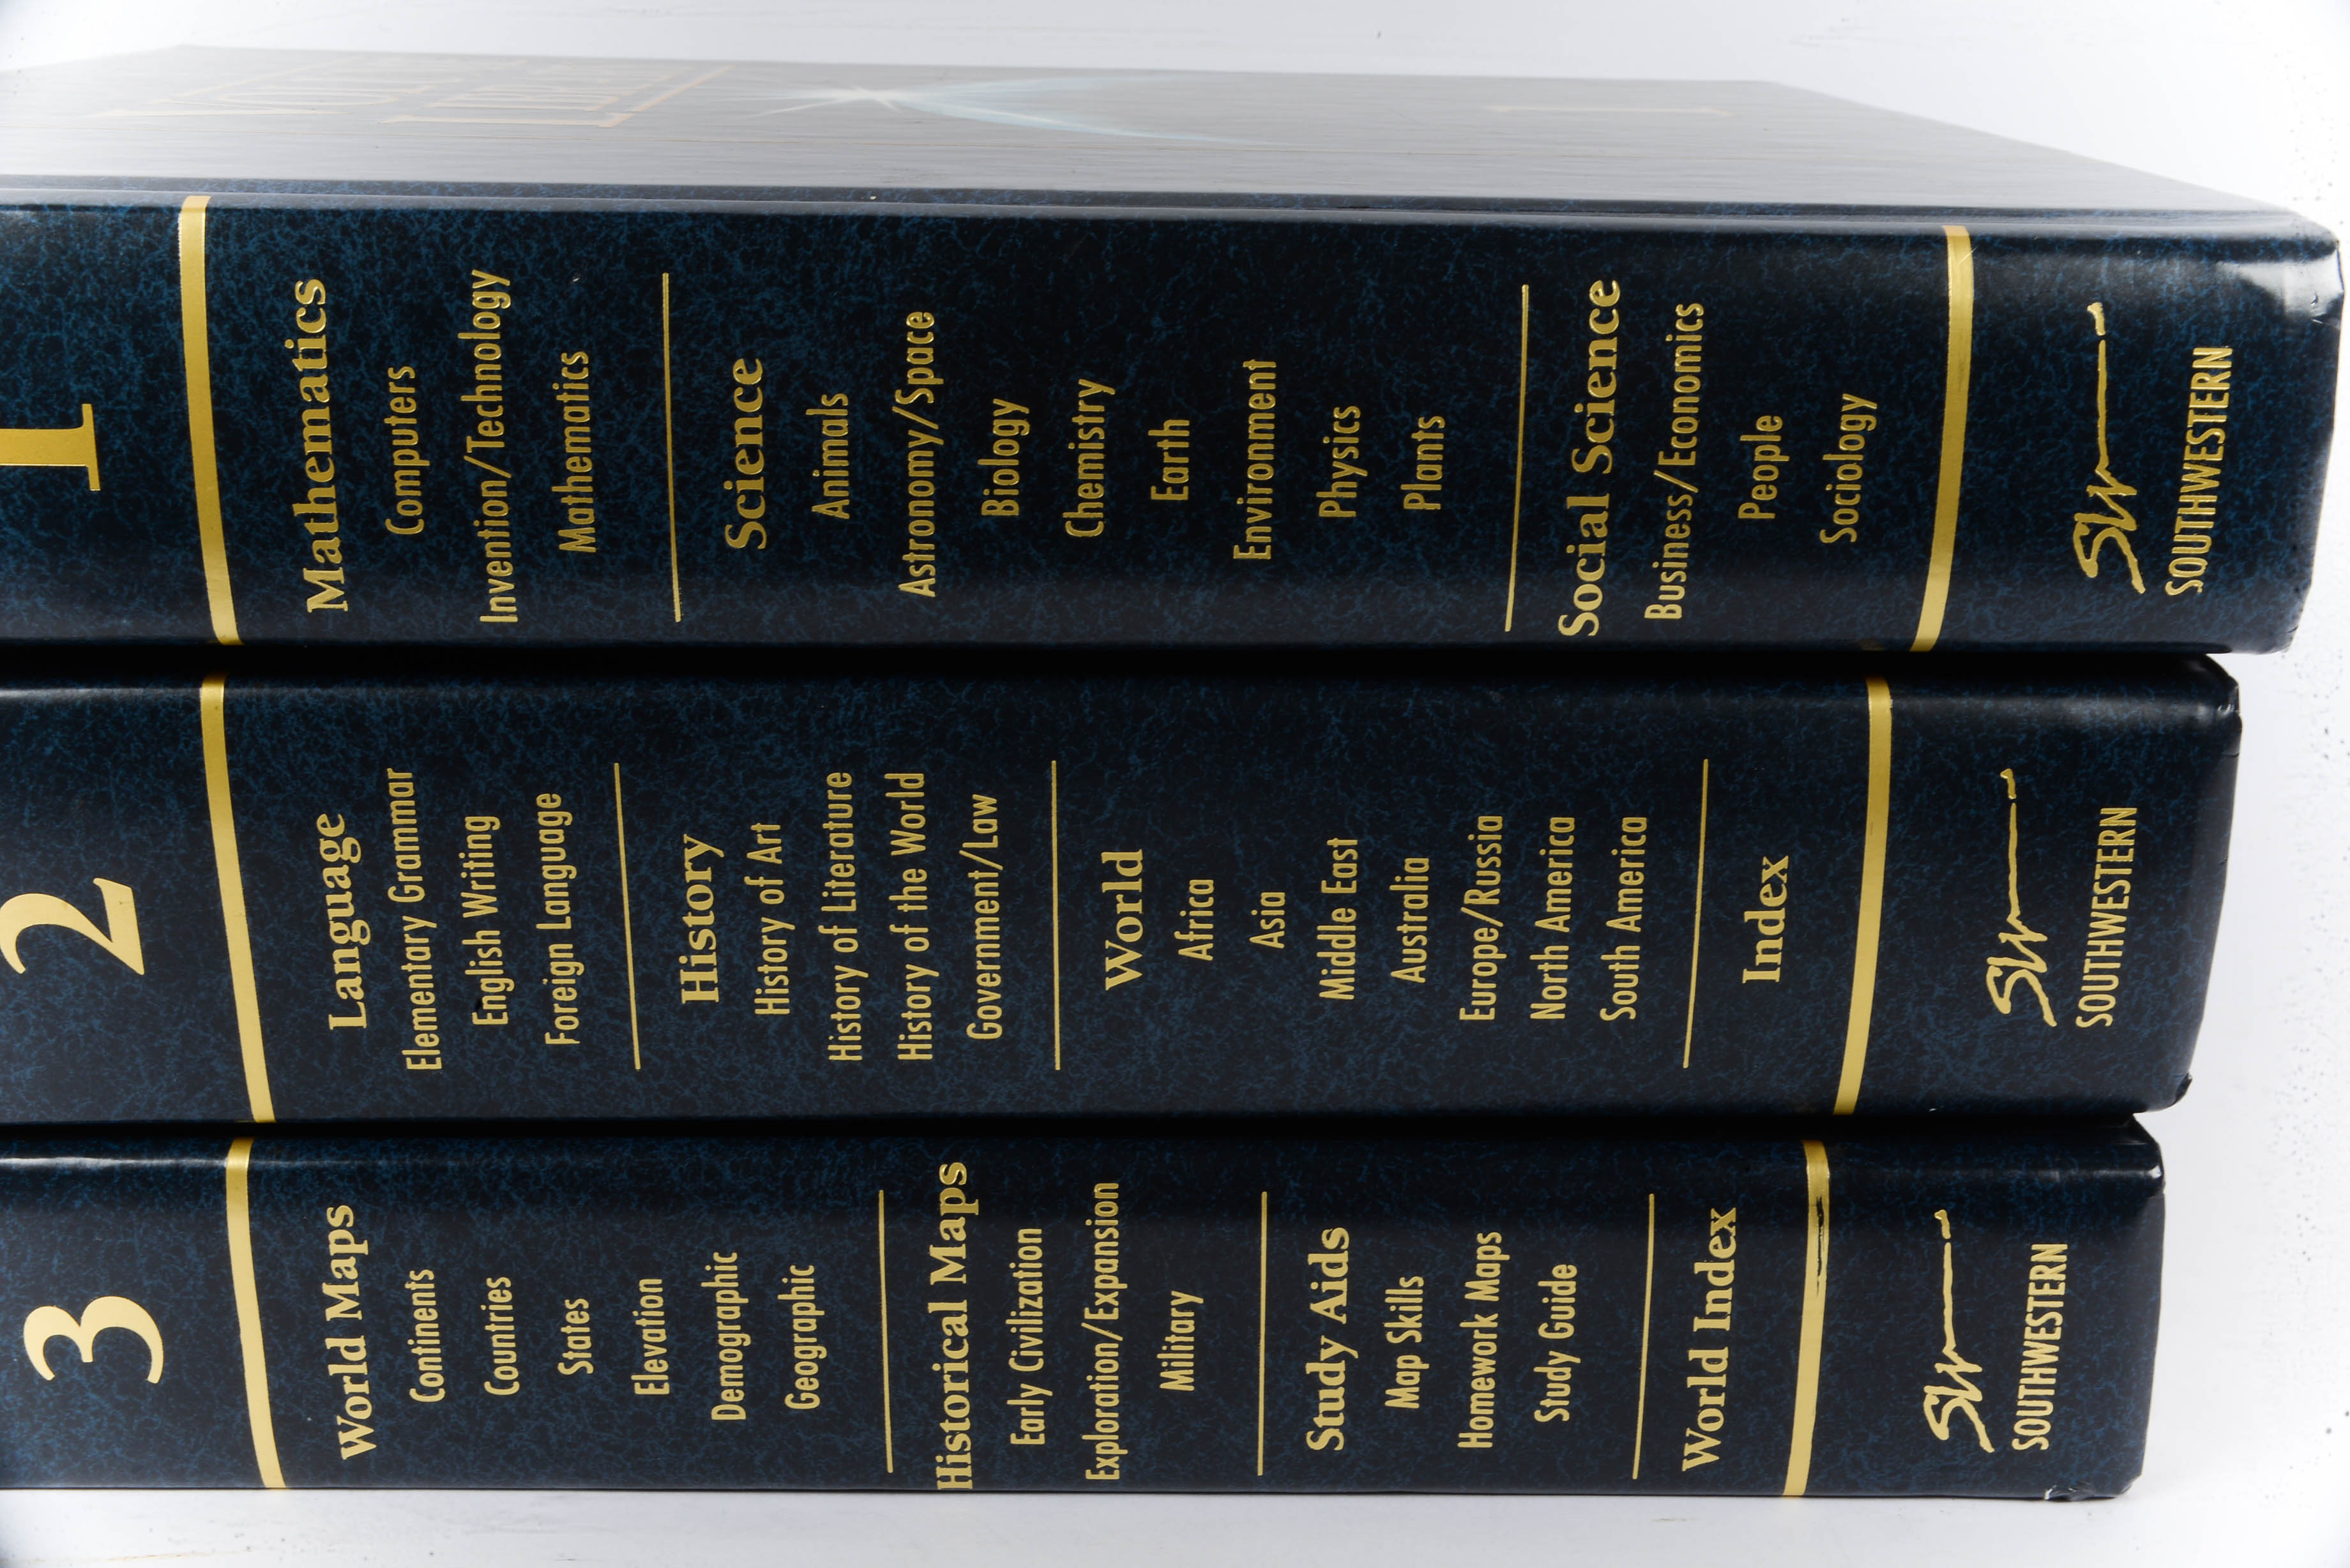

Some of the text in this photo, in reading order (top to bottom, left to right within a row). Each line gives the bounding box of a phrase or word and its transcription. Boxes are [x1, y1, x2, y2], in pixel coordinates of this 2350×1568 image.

[285, 279, 349, 613] Mathematics
[384, 366, 430, 534] Computers
[458, 269, 518, 622] Invention/Technology
[552, 351, 596, 552] Mathematics
[724, 358, 766, 549] Science
[806, 393, 849, 519] Animals
[892, 312, 944, 597] Astronomy/Space
[978, 398, 1030, 516] Biology
[1063, 379, 1115, 537] Chemistry
[1148, 419, 1190, 500] Earth
[1233, 359, 1277, 559] Environment
[1316, 406, 1367, 517] Physics
[1400, 416, 1445, 509] Plants
[1558, 280, 1620, 636] Social Science
[1644, 303, 1704, 619] Business/Economics
[1738, 416, 1789, 518] People
[1820, 393, 1877, 543] Sociology
[2165, 347, 2232, 596] SOUTHWESTERN
[0, 877, 145, 976] 2
[317, 814, 371, 1030] Language
[387, 768, 442, 1069] Elementary Grammar
[460, 817, 515, 1025] English Writing
[536, 794, 584, 1044] Foreign Language
[678, 834, 724, 1004] History
[744, 823, 795, 1014] History of Art
[818, 773, 868, 1060] History of Literature
[884, 773, 939, 1060] History of the World
[959, 794, 1003, 1039] Government/Law
[1101, 849, 1143, 990] World
[1174, 880, 1214, 961] Africa
[1249, 892, 1285, 949] Asia
[1316, 838, 1358, 1000] Middle East
[1390, 858, 1429, 983] Australia
[1459, 816, 1507, 1020] Europe/Russia
[1529, 817, 1575, 1019] North America
[1600, 817, 1647, 1021] South America
[1742, 856, 1789, 983] Index
[2075, 808, 2137, 1028] SOUTHWESTERN
[24, 1295, 165, 1384] 3
[322, 1205, 377, 1459] World Maps
[404, 1269, 446, 1402] Continents
[480, 1277, 520, 1396] Countries
[557, 1299, 594, 1375] States
[631, 1279, 669, 1394] Elevation
[701, 1252, 751, 1420] Demographic
[777, 1265, 827, 1409] Geographic
[927, 1162, 979, 1489] Historical Maps
[1006, 1228, 1052, 1445] Early Civilization
[1081, 1183, 1128, 1480] Exploration/Expansion
[1156, 1290, 1204, 1391] Military
[1305, 1227, 1359, 1451] Study Aids
[1384, 1276, 1430, 1409] Map Skills
[1457, 1232, 1510, 1448] Homework Maps
[1534, 1264, 1581, 1422] Study Guide
[1682, 1207, 1736, 1471] World Index
[2011, 1244, 2068, 1451] SOUTHWESTERN
